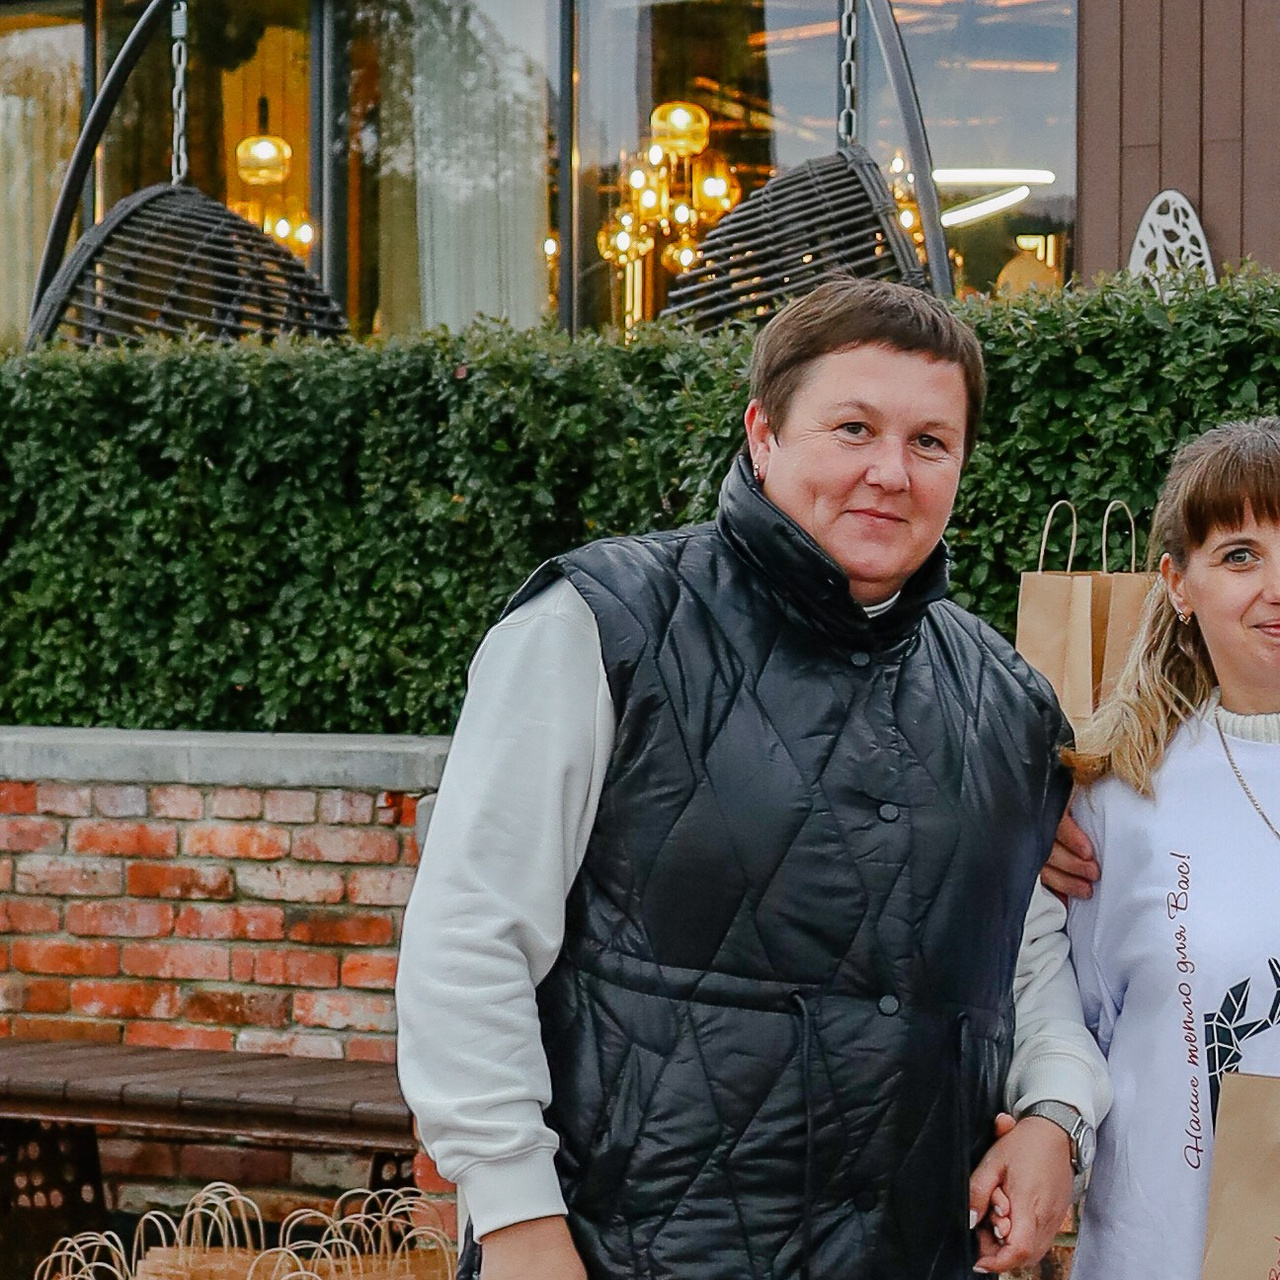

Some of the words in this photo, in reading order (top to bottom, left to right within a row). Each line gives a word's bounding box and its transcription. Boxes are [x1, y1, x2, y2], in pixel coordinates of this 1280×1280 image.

[1166, 851, 1193, 921] Вас!
[1174, 923, 1195, 974] для
[1178, 981, 1200, 1067] тепло
[1183, 1074, 1202, 1170] Наше
